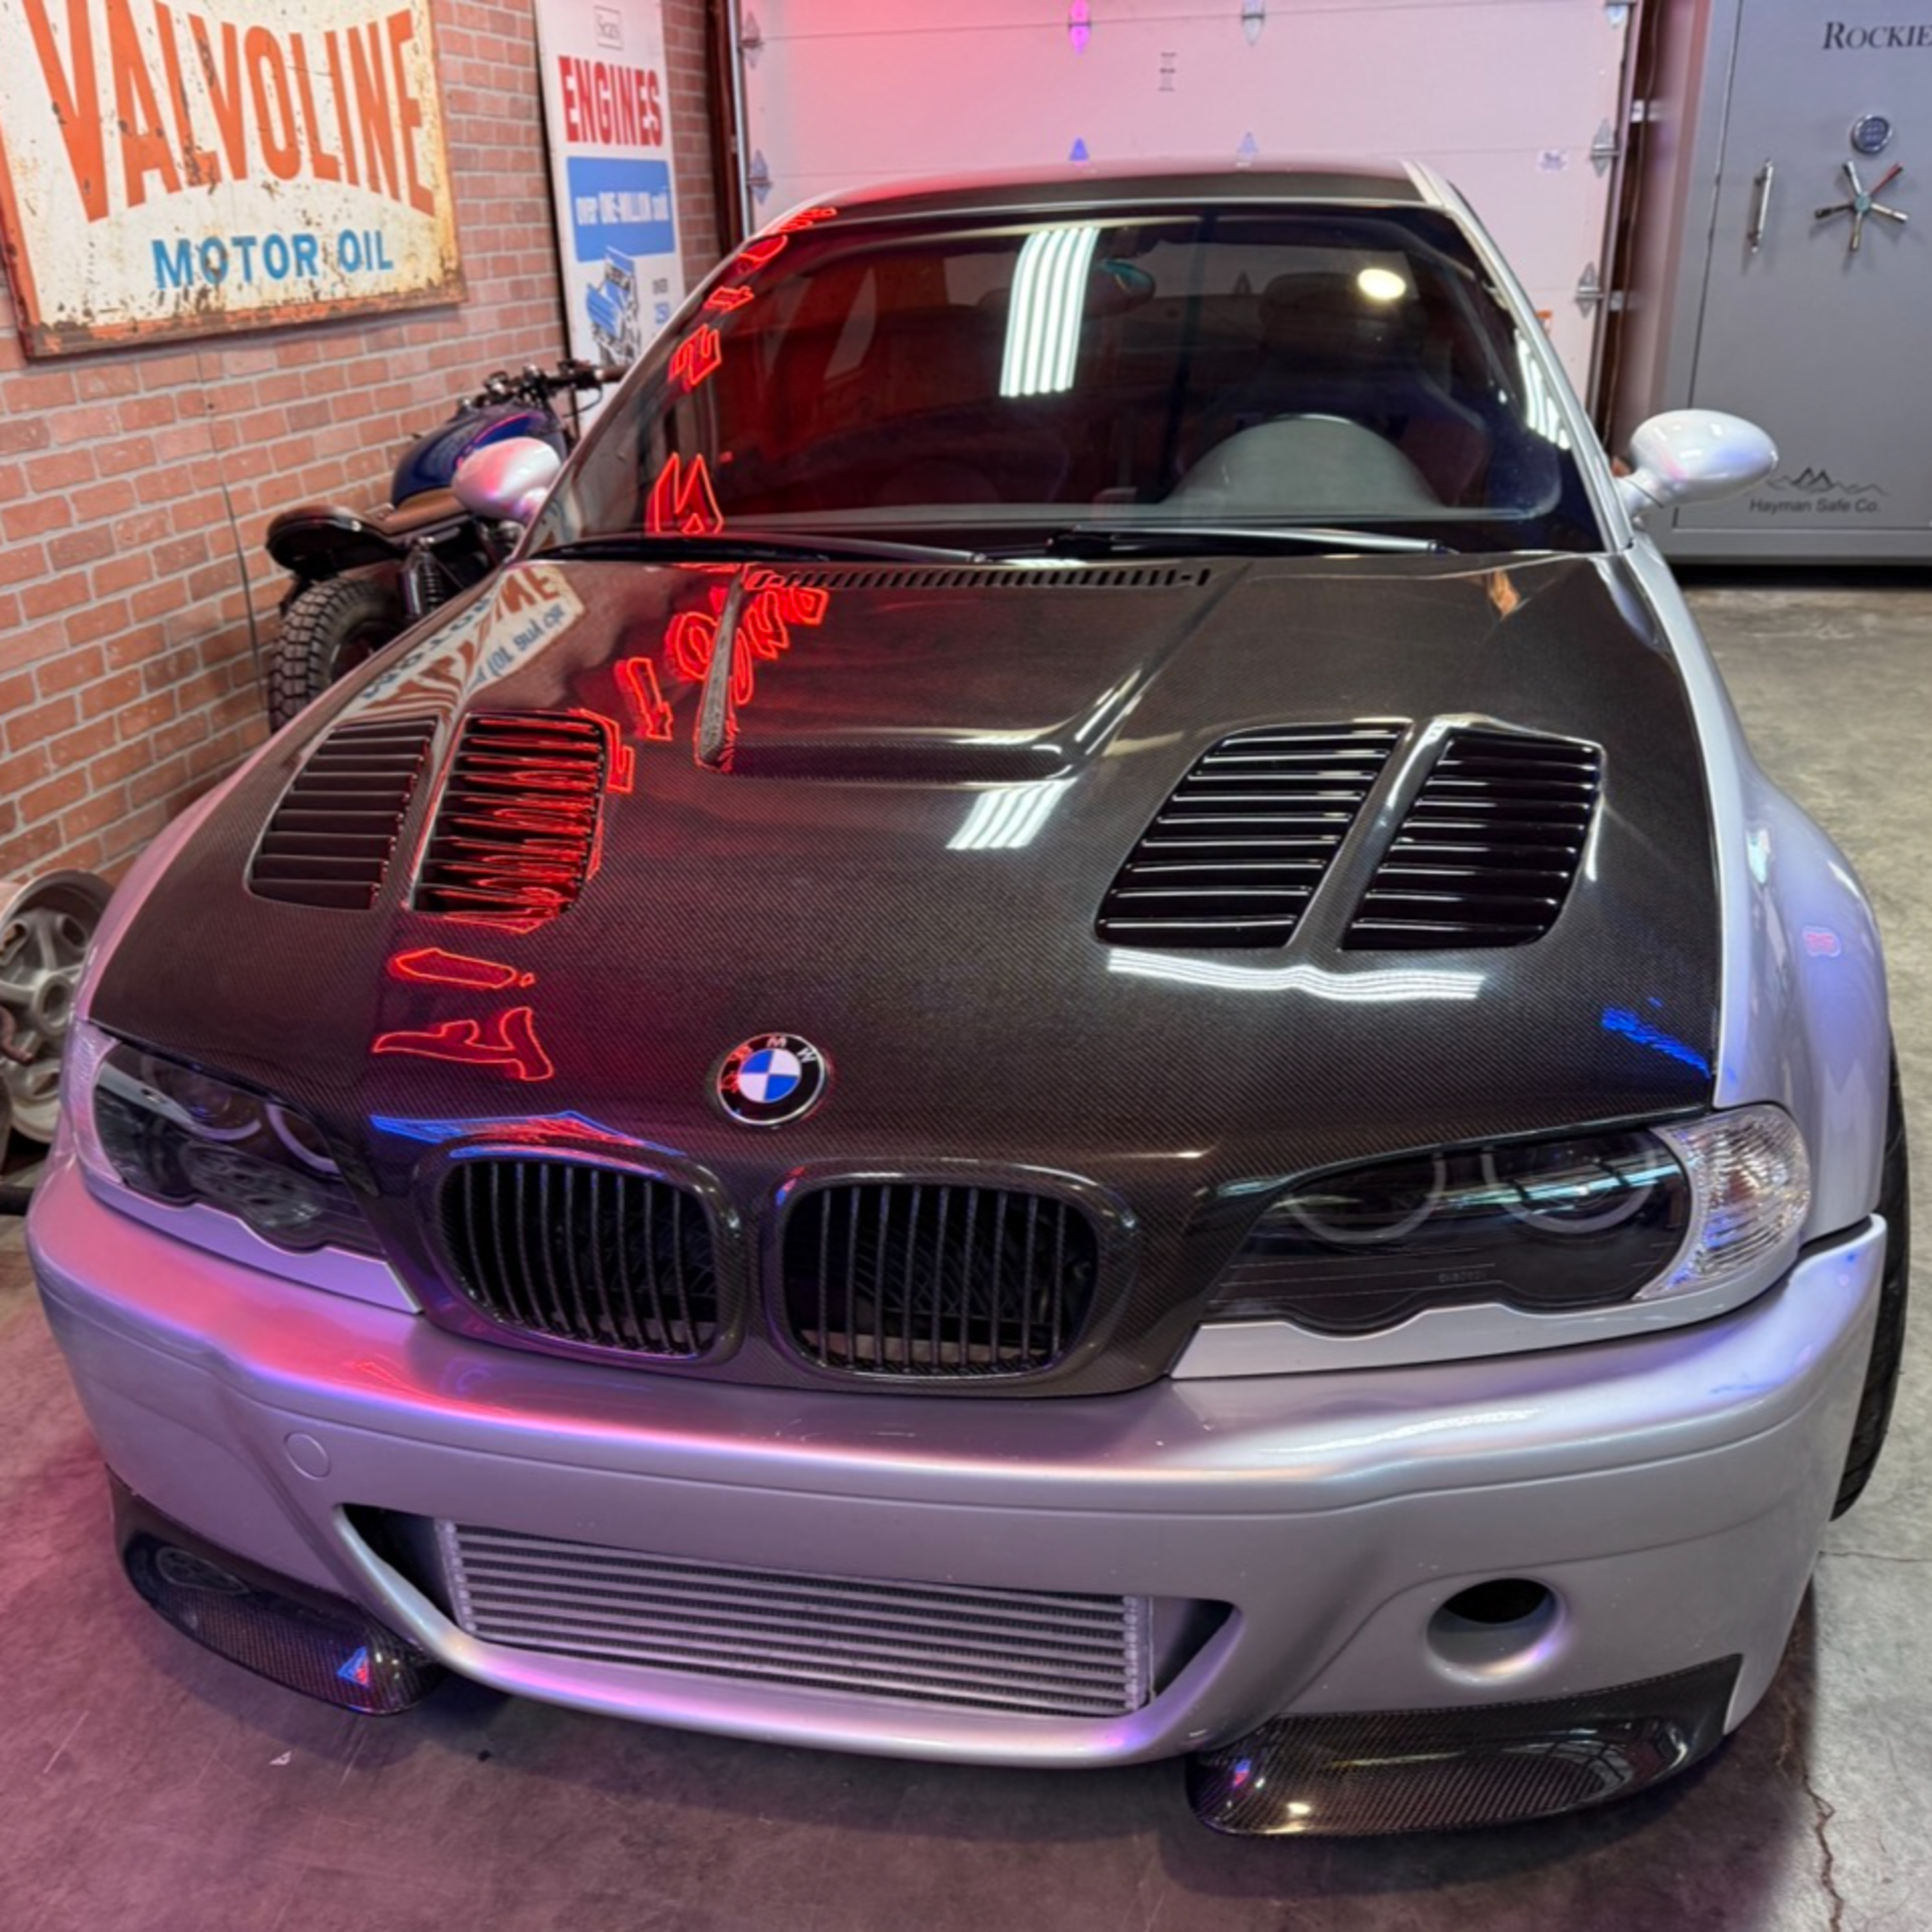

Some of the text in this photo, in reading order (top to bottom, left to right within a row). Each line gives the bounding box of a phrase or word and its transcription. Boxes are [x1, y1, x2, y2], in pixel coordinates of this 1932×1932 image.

[21, 0, 436, 223] VALVOLINE
[558, 55, 664, 147] ENGINES
[151, 229, 393, 289] MOTOR OIL
[1749, 498, 1812, 514] Hayman
[1816, 498, 1851, 513] Safe
